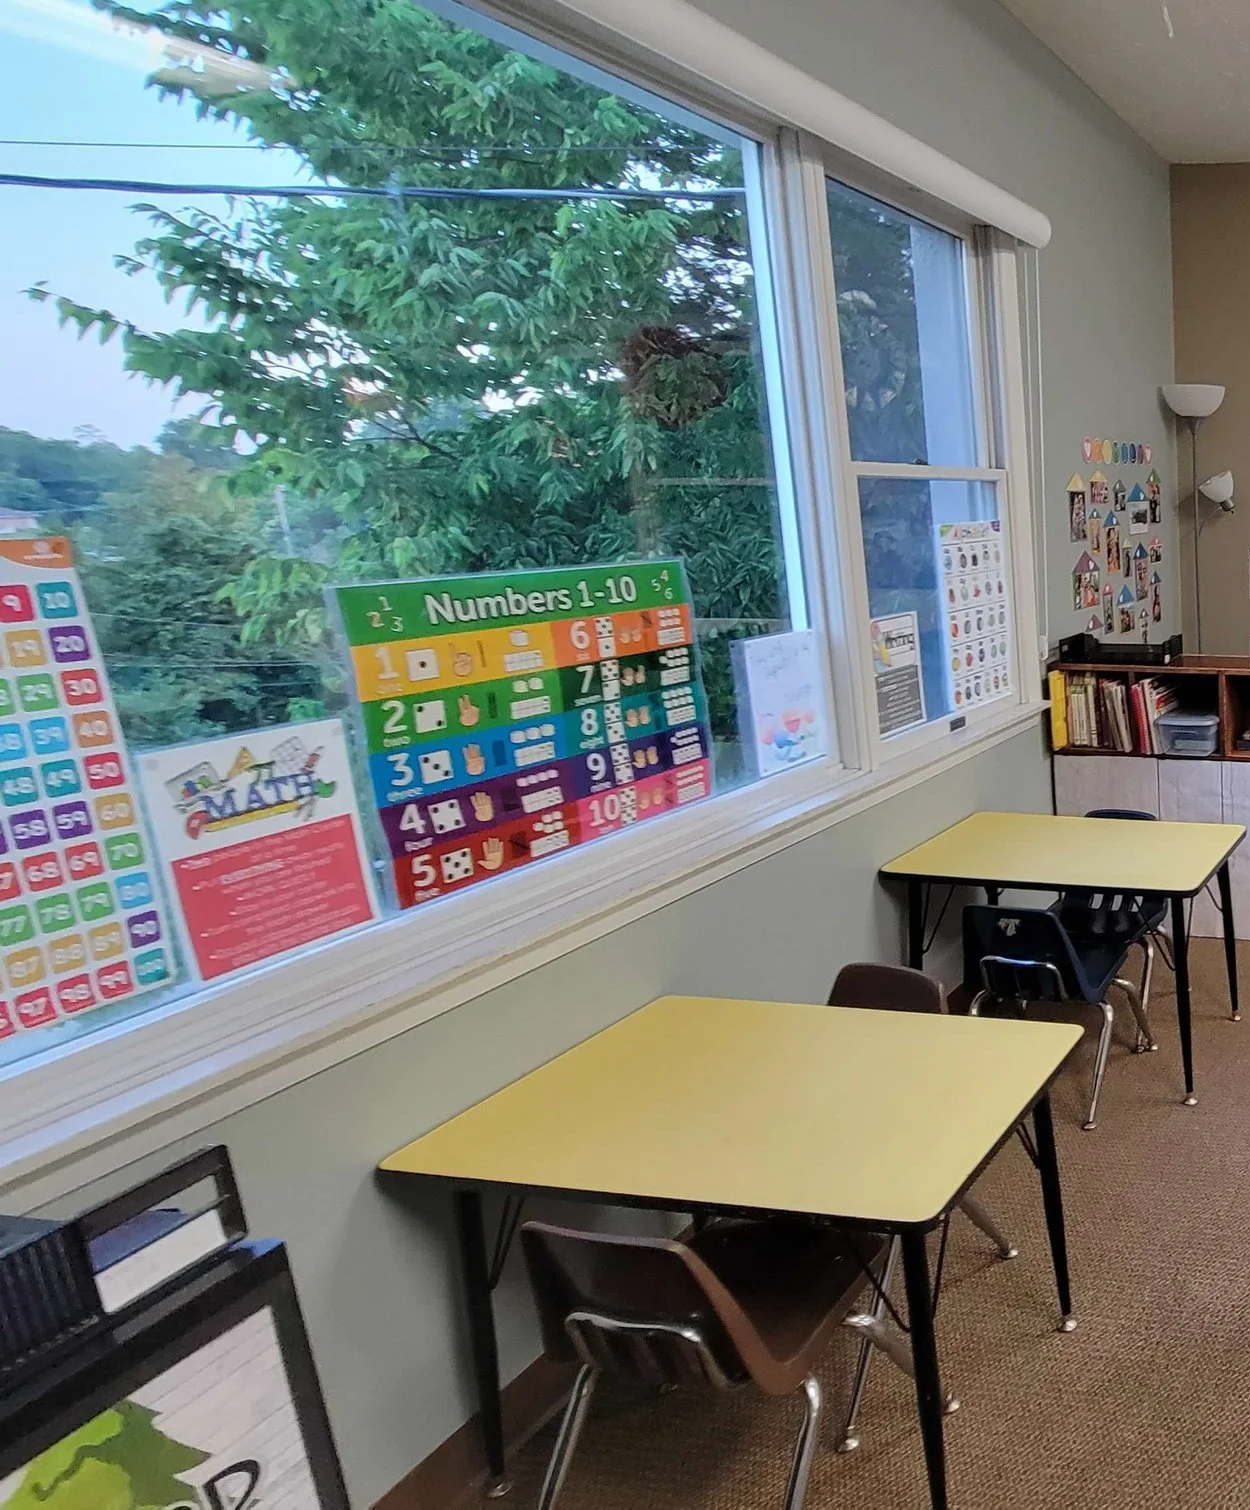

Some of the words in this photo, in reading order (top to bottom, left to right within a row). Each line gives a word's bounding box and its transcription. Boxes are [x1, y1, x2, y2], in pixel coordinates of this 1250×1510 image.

[651, 578, 661, 592] 5
[664, 587, 674, 600] 6
[1, 594, 22, 612] 9
[43, 591, 71, 609] 10
[378, 596, 393, 612] 1
[424, 587, 573, 626] Numbers
[576, 575, 638, 608] 1-10
[366, 611, 385, 628] 2
[390, 616, 404, 633] 3
[569, 620, 591, 649] 6
[11, 639, 40, 658] 19
[52, 635, 85, 653] 20
[374, 646, 400, 680] 1
[21, 683, 53, 702] 29
[65, 678, 97, 696] 30
[575, 664, 595, 694] 7
[33, 726, 64, 745] 39
[80, 719, 108, 738] 40
[380, 700, 409, 734] 2
[580, 708, 600, 736] 8
[4, 776, 36, 796] 48
[46, 768, 77, 787] 49
[88, 761, 120, 780] 50
[386, 752, 415, 786] 3
[586, 752, 607, 781] 9
[200, 768, 320, 820] MATH
[13, 819, 48, 840] 58
[55, 810, 88, 830] 59
[101, 802, 130, 821] 60
[399, 803, 427, 834] 4
[588, 794, 621, 827] 10
[28, 861, 59, 882] 68
[70, 851, 100, 871] 69
[109, 842, 139, 861] 70
[411, 854, 437, 887] 5
[0, 915, 26, 938] 77
[40, 903, 71, 925] 78
[82, 892, 111, 913] 79
[11, 955, 41, 978] 87
[18, 996, 47, 1017] 97
[60, 983, 92, 1003] 98
[100, 970, 129, 989] 99
